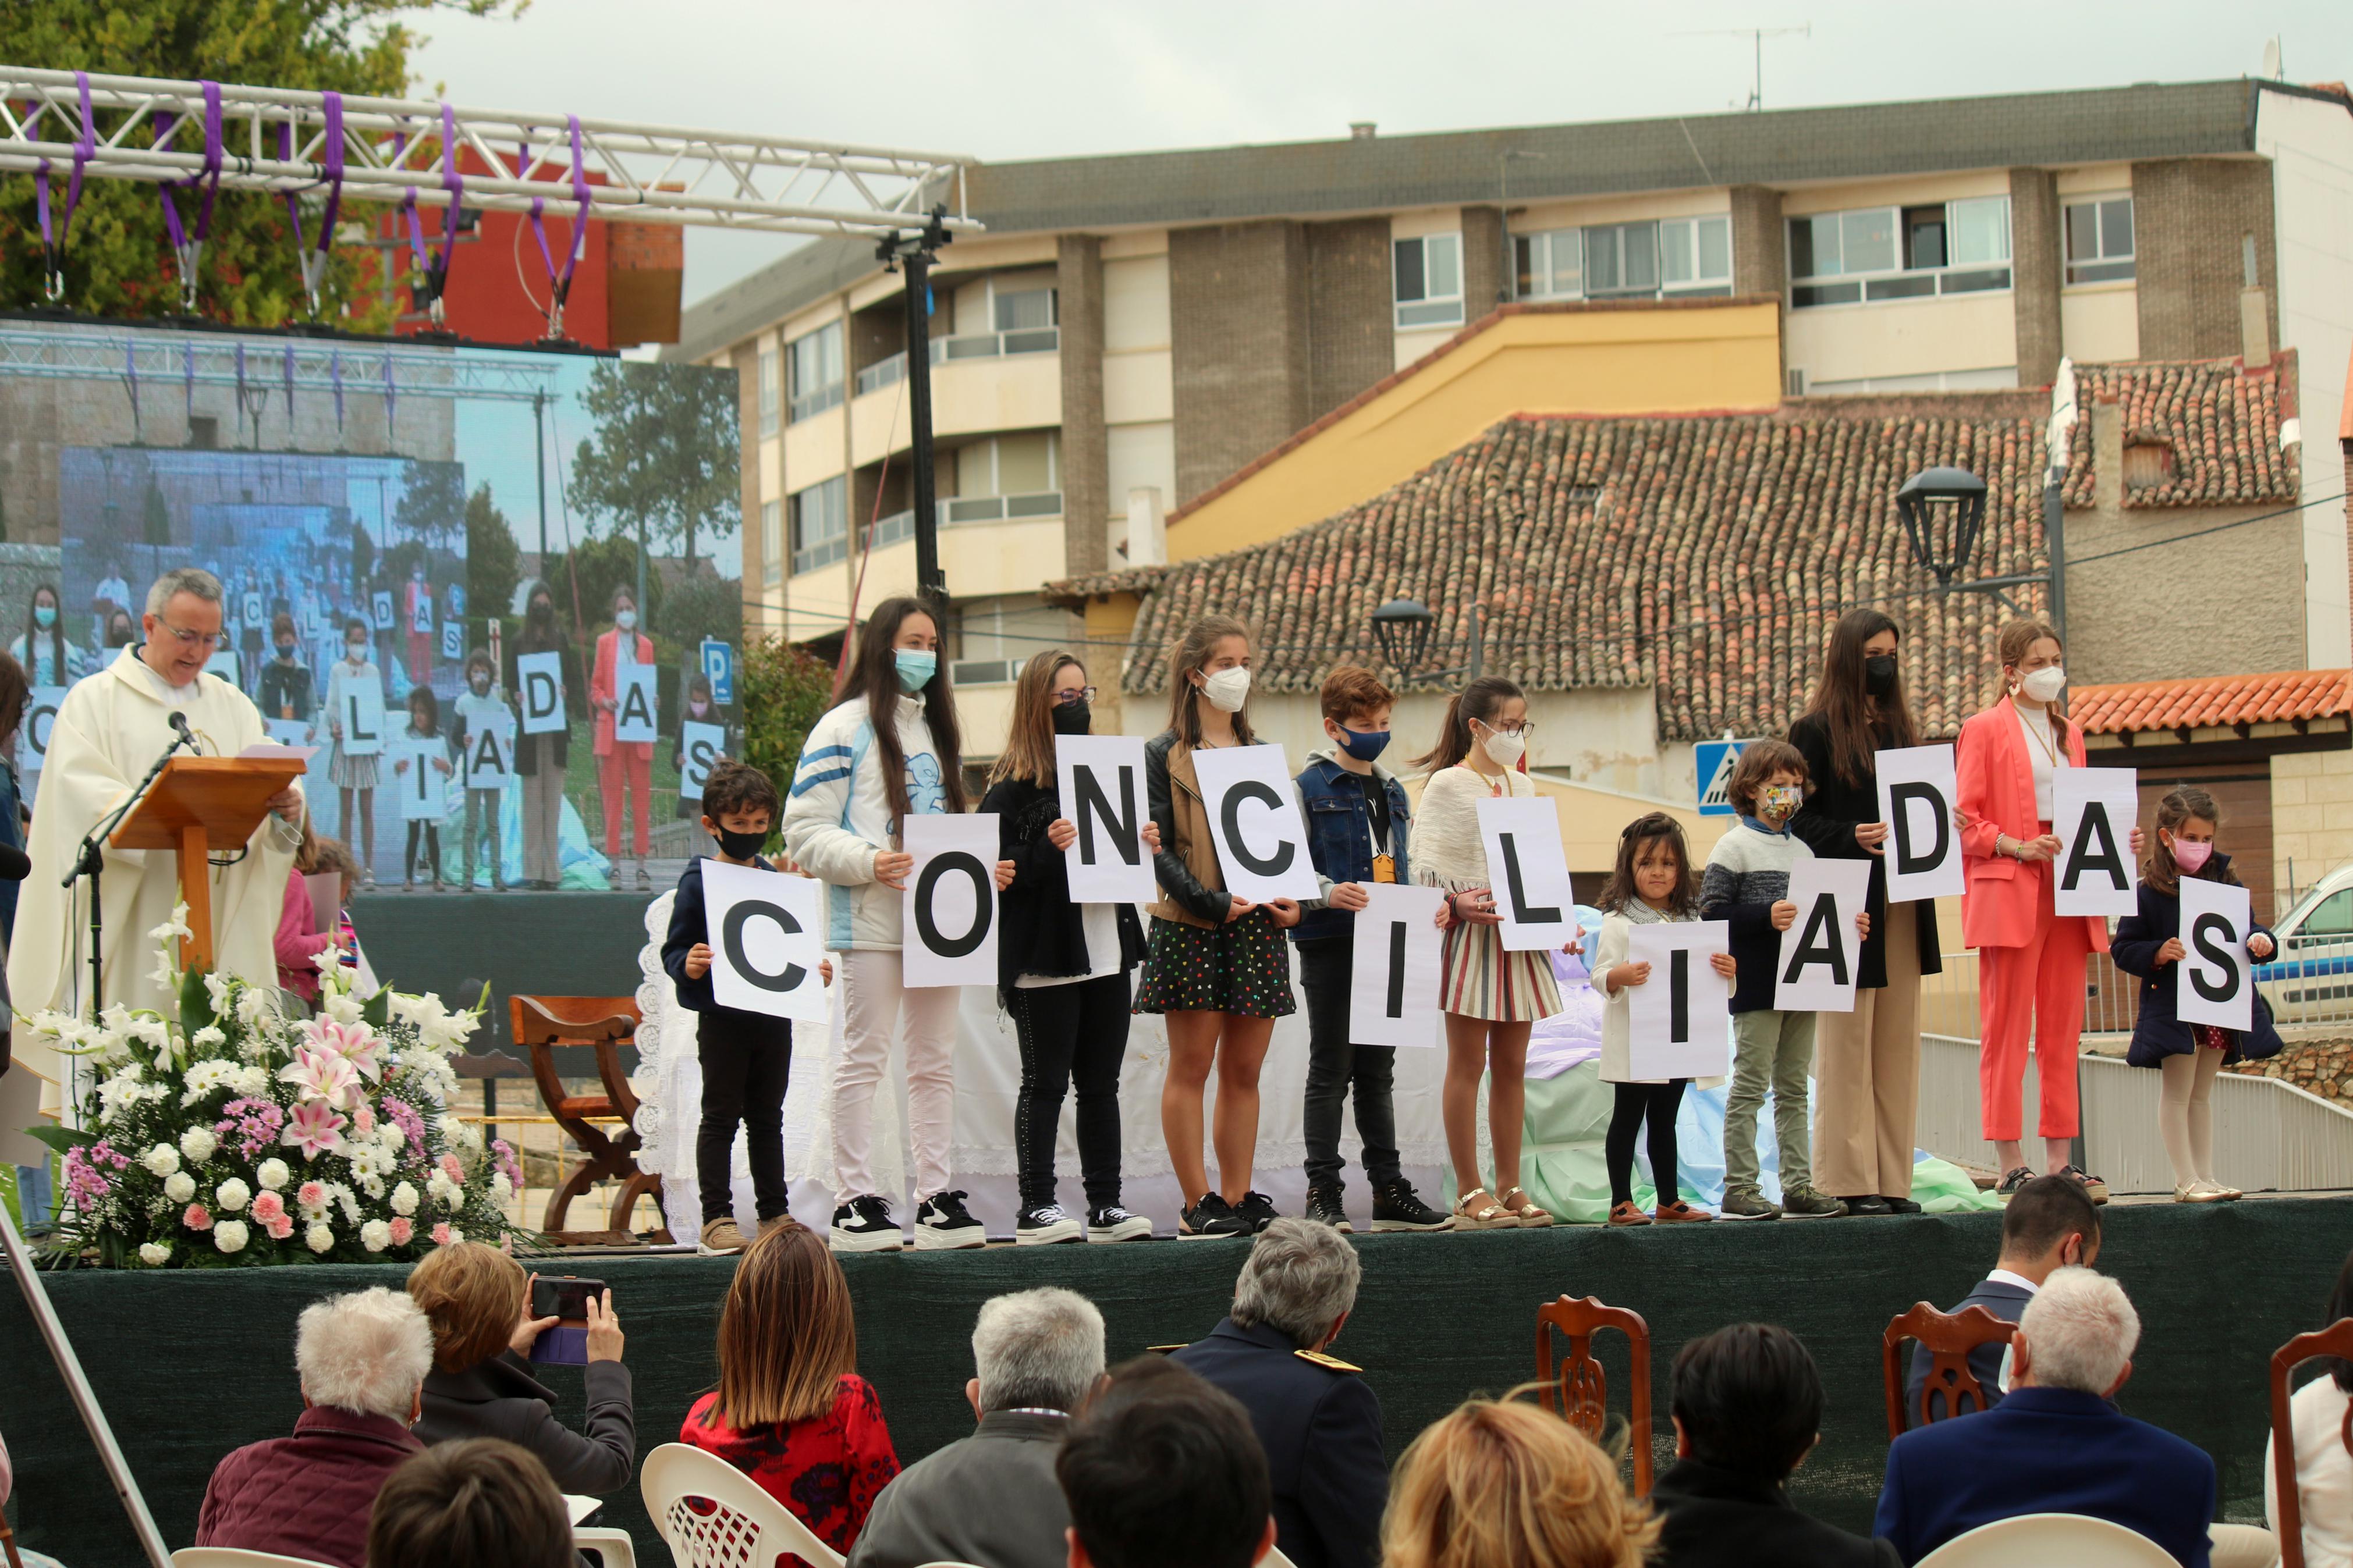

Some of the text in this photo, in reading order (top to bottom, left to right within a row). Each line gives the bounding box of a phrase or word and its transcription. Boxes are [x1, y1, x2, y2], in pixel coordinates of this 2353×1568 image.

[377, 600, 389, 621] D
[417, 604, 430, 625] A
[446, 630, 458, 651] S
[349, 695, 377, 740] L
[526, 671, 556, 719] D
[619, 681, 653, 728] A
[708, 650, 726, 695] P
[417, 753, 426, 800] I
[471, 728, 506, 774] A
[688, 739, 715, 787] S
[1073, 765, 1141, 866] N
[1220, 780, 1296, 877] C
[1890, 781, 1949, 875] D
[2060, 801, 2130, 891] A
[914, 851, 993, 958] O
[1499, 833, 1562, 924] L
[723, 899, 807, 992] C
[1386, 921, 1407, 1018] I
[1781, 893, 1850, 985] A
[2189, 912, 2240, 1002] S
[1670, 949, 1688, 1043] I
